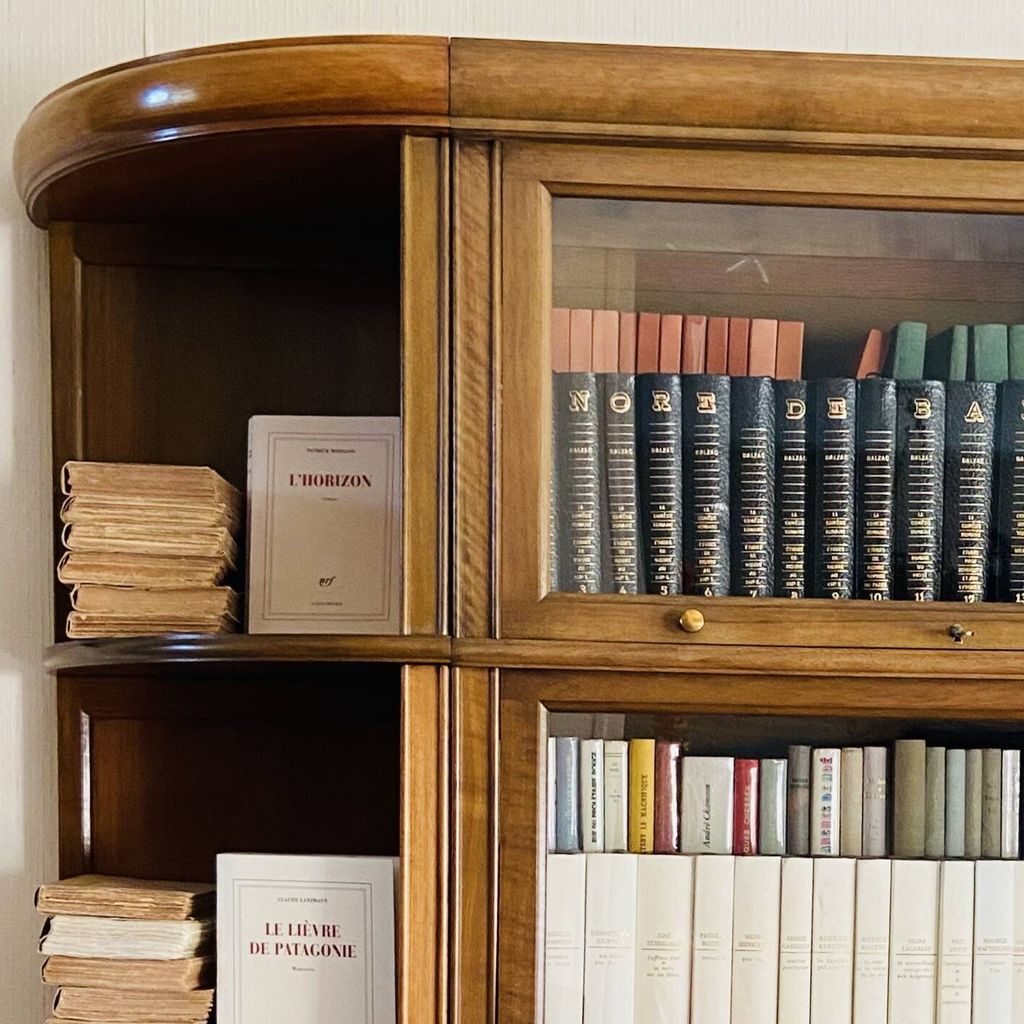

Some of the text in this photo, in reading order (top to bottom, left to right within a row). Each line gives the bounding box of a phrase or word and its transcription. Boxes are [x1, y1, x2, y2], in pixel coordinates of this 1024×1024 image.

[290, 473, 372, 488] L'HORIZON
[319, 576, 337, 588] nrf
[660, 585, 668, 595] 5
[704, 587, 712, 596] 6
[750, 589, 758, 598] 7
[640, 774, 648, 818] MAGNIFIQUE
[702, 822, 710, 848] André
[265, 920, 341, 938] LE LIÈVRE
[250, 942, 357, 958] DE PATAGONIE
